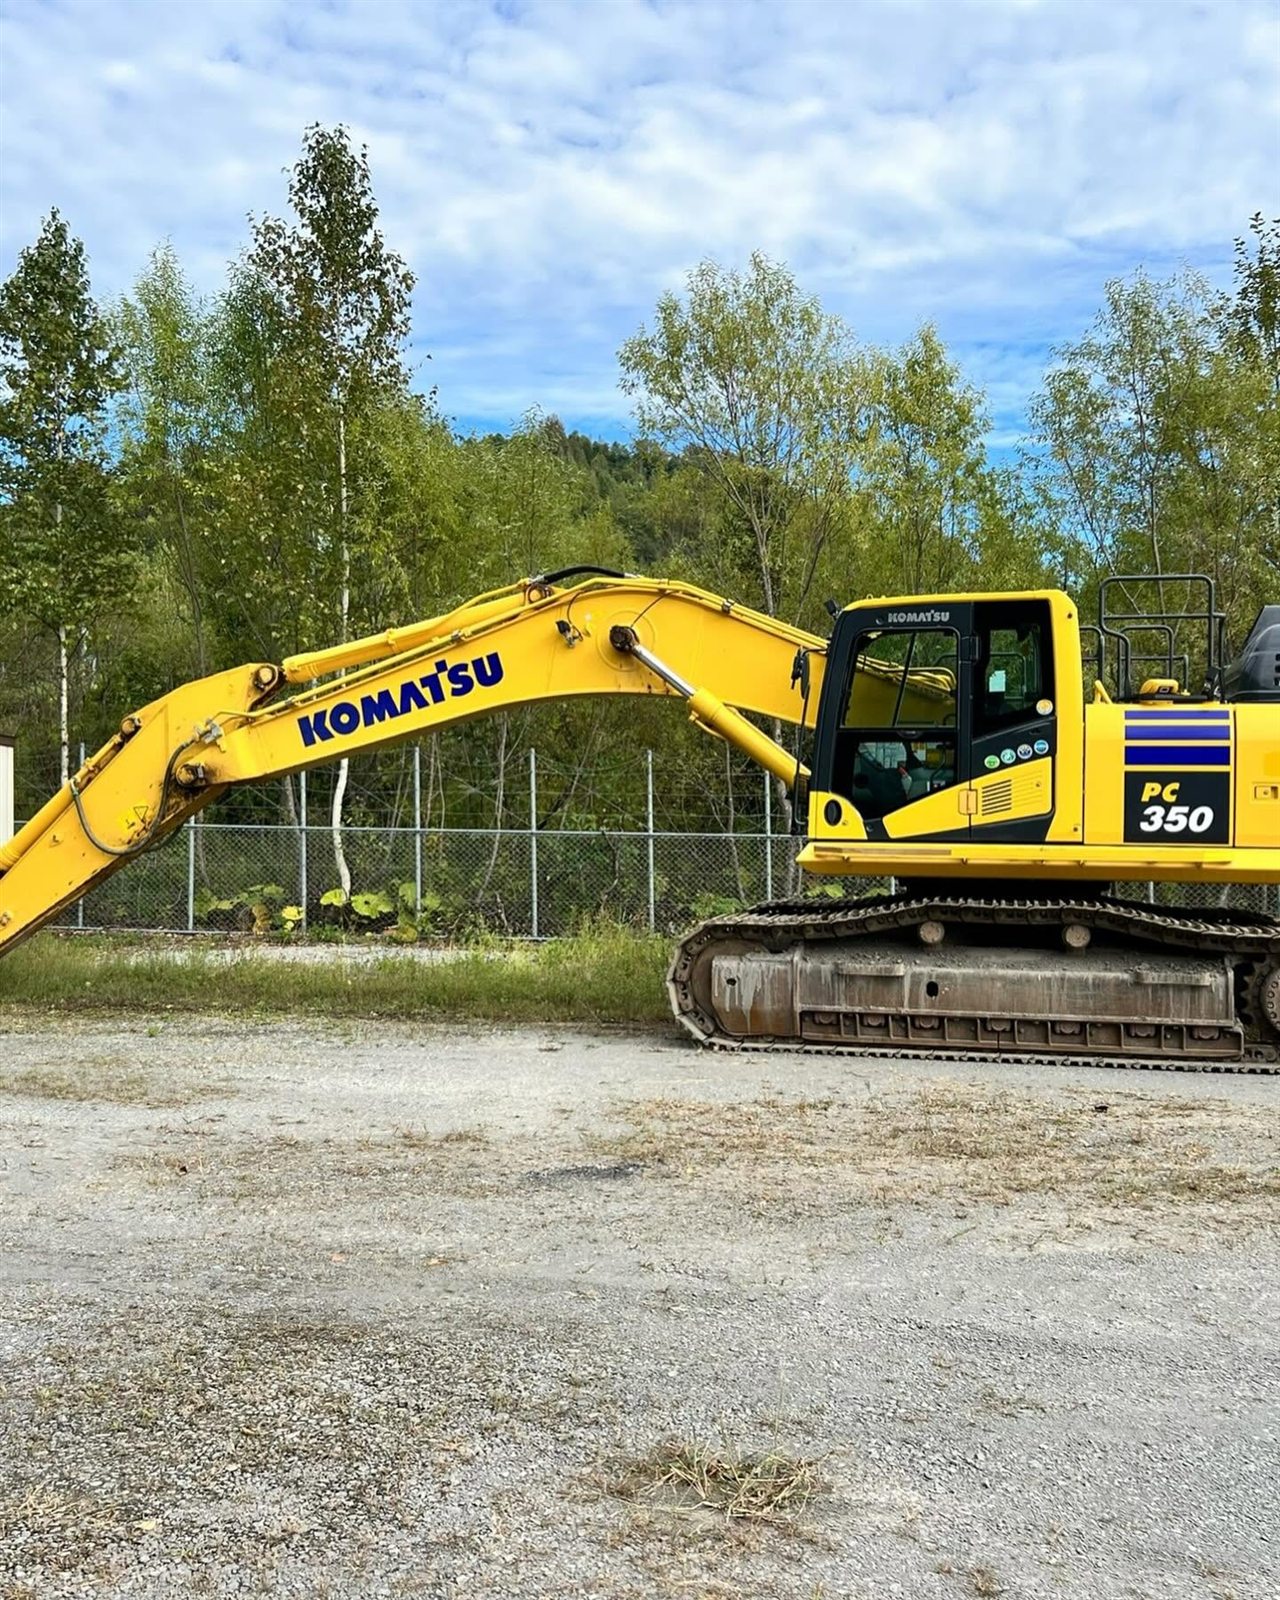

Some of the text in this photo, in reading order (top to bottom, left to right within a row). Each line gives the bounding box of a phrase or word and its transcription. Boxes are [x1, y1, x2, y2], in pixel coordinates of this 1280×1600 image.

[888, 609, 950, 623] KOMATSU
[297, 652, 504, 747] KOMATSU
[1141, 782, 1180, 802] PC
[1139, 805, 1214, 833] 350
